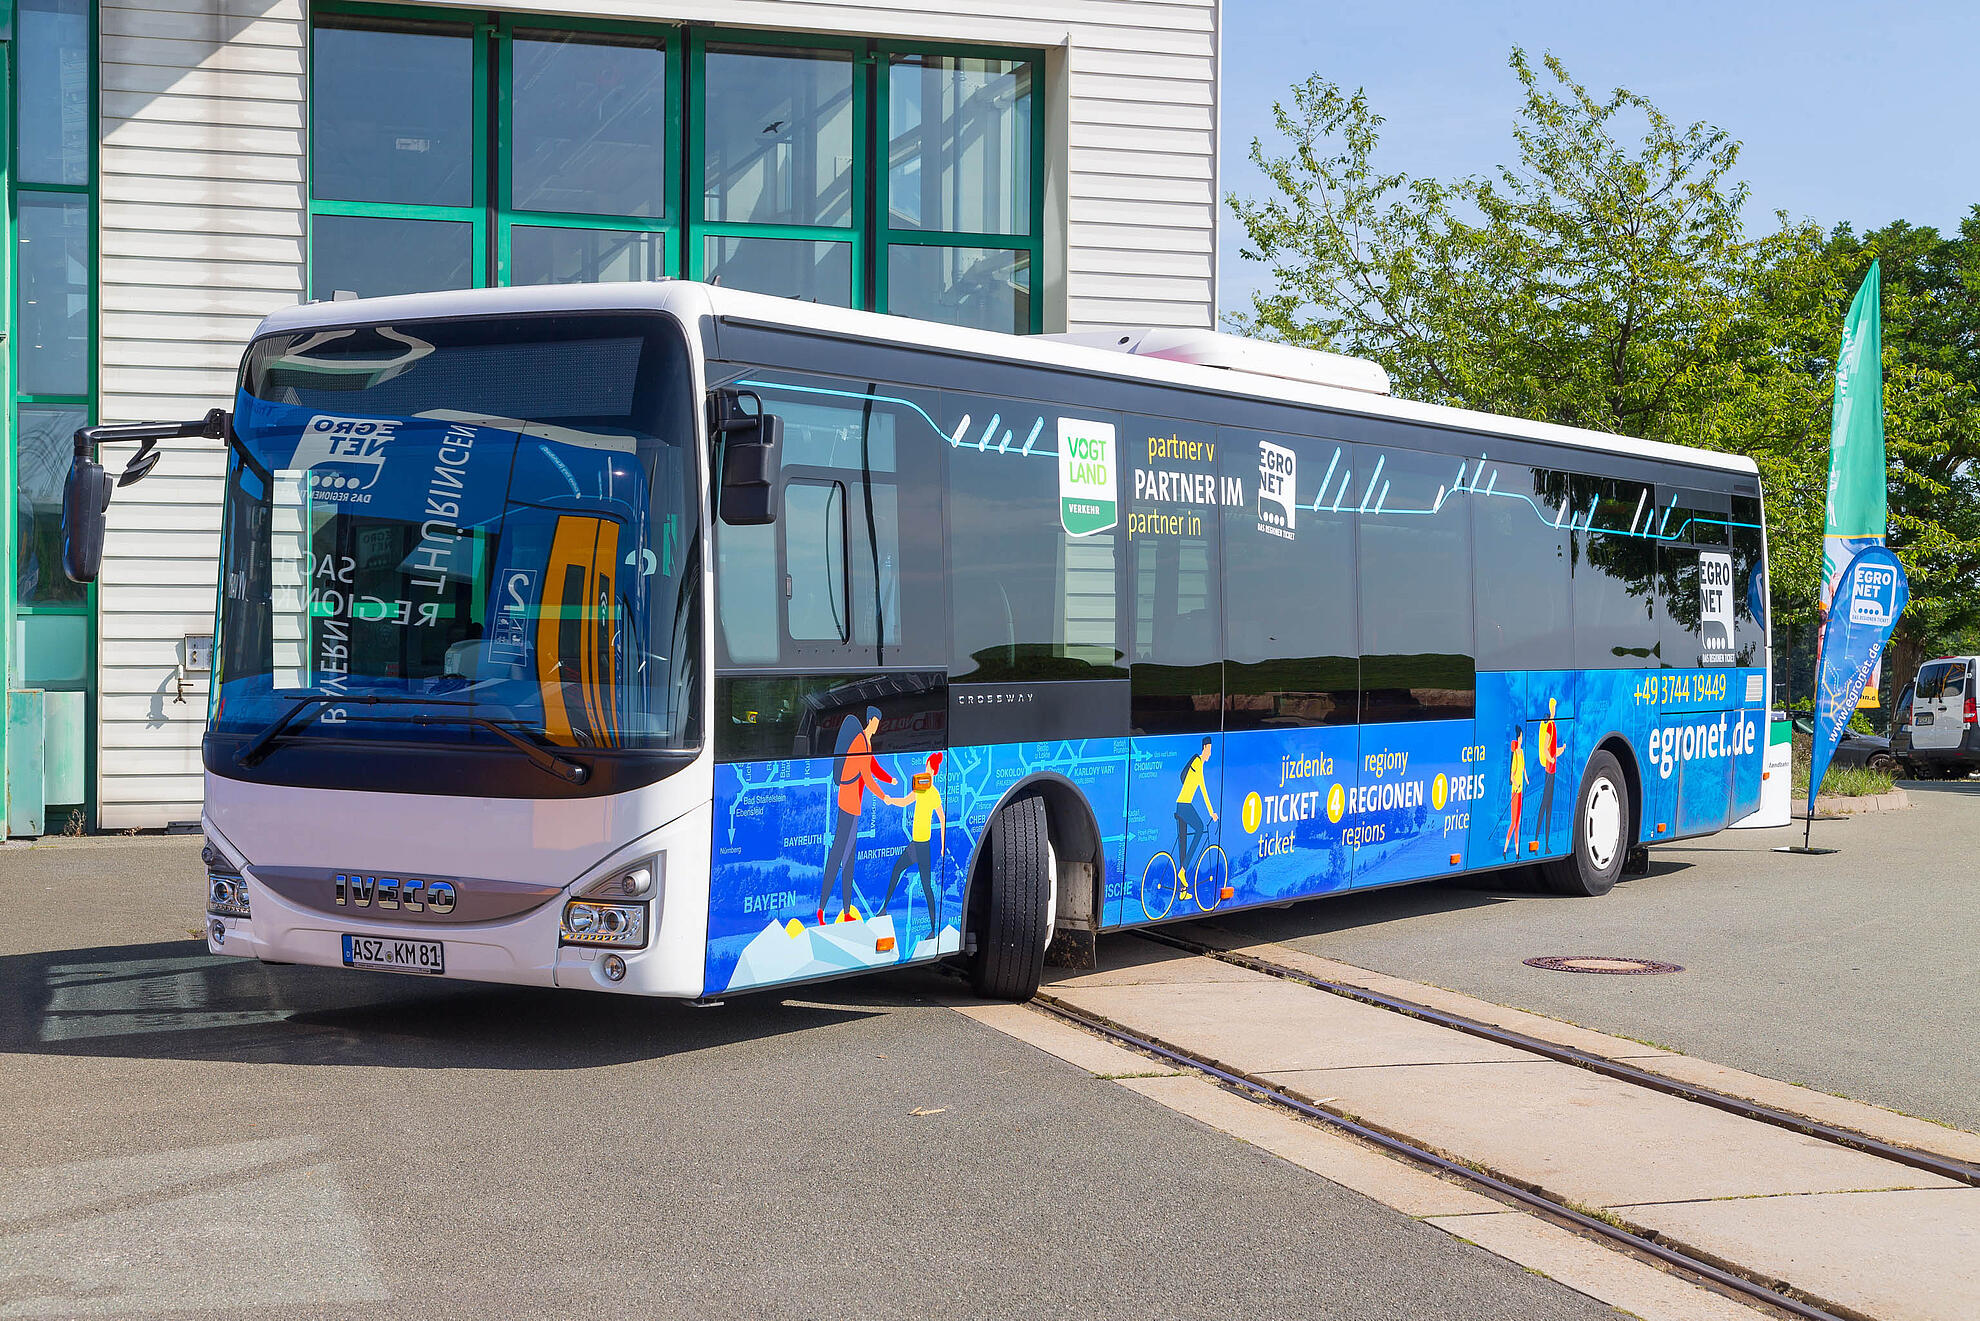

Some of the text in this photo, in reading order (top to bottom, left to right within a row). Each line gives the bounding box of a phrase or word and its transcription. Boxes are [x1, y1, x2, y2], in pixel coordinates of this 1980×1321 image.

[1067, 436, 1107, 461] VOGT
[1148, 433, 1215, 464] partner v
[1069, 462, 1107, 486] LAND
[1259, 450, 1293, 476] EGRO
[1134, 468, 1244, 507] PARTNER IM
[1259, 470, 1284, 496] NET
[1068, 503, 1100, 516] VERKEHR
[1128, 509, 1201, 541] partner in
[1700, 556, 1730, 586] EGRO
[1857, 570, 1891, 586] EGRO
[1701, 588, 1723, 613] NET
[1855, 583, 1881, 598] NET
[958, 693, 1033, 705] CROSSWAY
[1634, 672, 1726, 705] +49 3744 19449
[1829, 642, 1880, 742] www.egronet.de
[1461, 744, 1486, 763] cena
[1649, 709, 1755, 779] egronet.de
[996, 768, 1024, 779] SOKOLOV
[1074, 766, 1099, 777] KARLOVY
[1100, 765, 1115, 775] VARY
[1279, 751, 1333, 788] jízdenka
[1364, 750, 1408, 778] regiony
[1264, 791, 1319, 825] TICKET
[1330, 794, 1341, 817] 4
[1348, 780, 1424, 815] REGIONEN
[1450, 773, 1485, 803] PREIS
[968, 815, 985, 825] CHEB
[1443, 809, 1470, 838] price
[783, 834, 822, 847] BAYREUTH
[1258, 832, 1295, 858] ticket
[1341, 822, 1386, 851] regions
[335, 873, 457, 915] IVECO
[743, 890, 796, 914] BAYERN
[353, 939, 385, 962] ASZ
[394, 943, 416, 965] KM
[420, 945, 440, 967] 81
